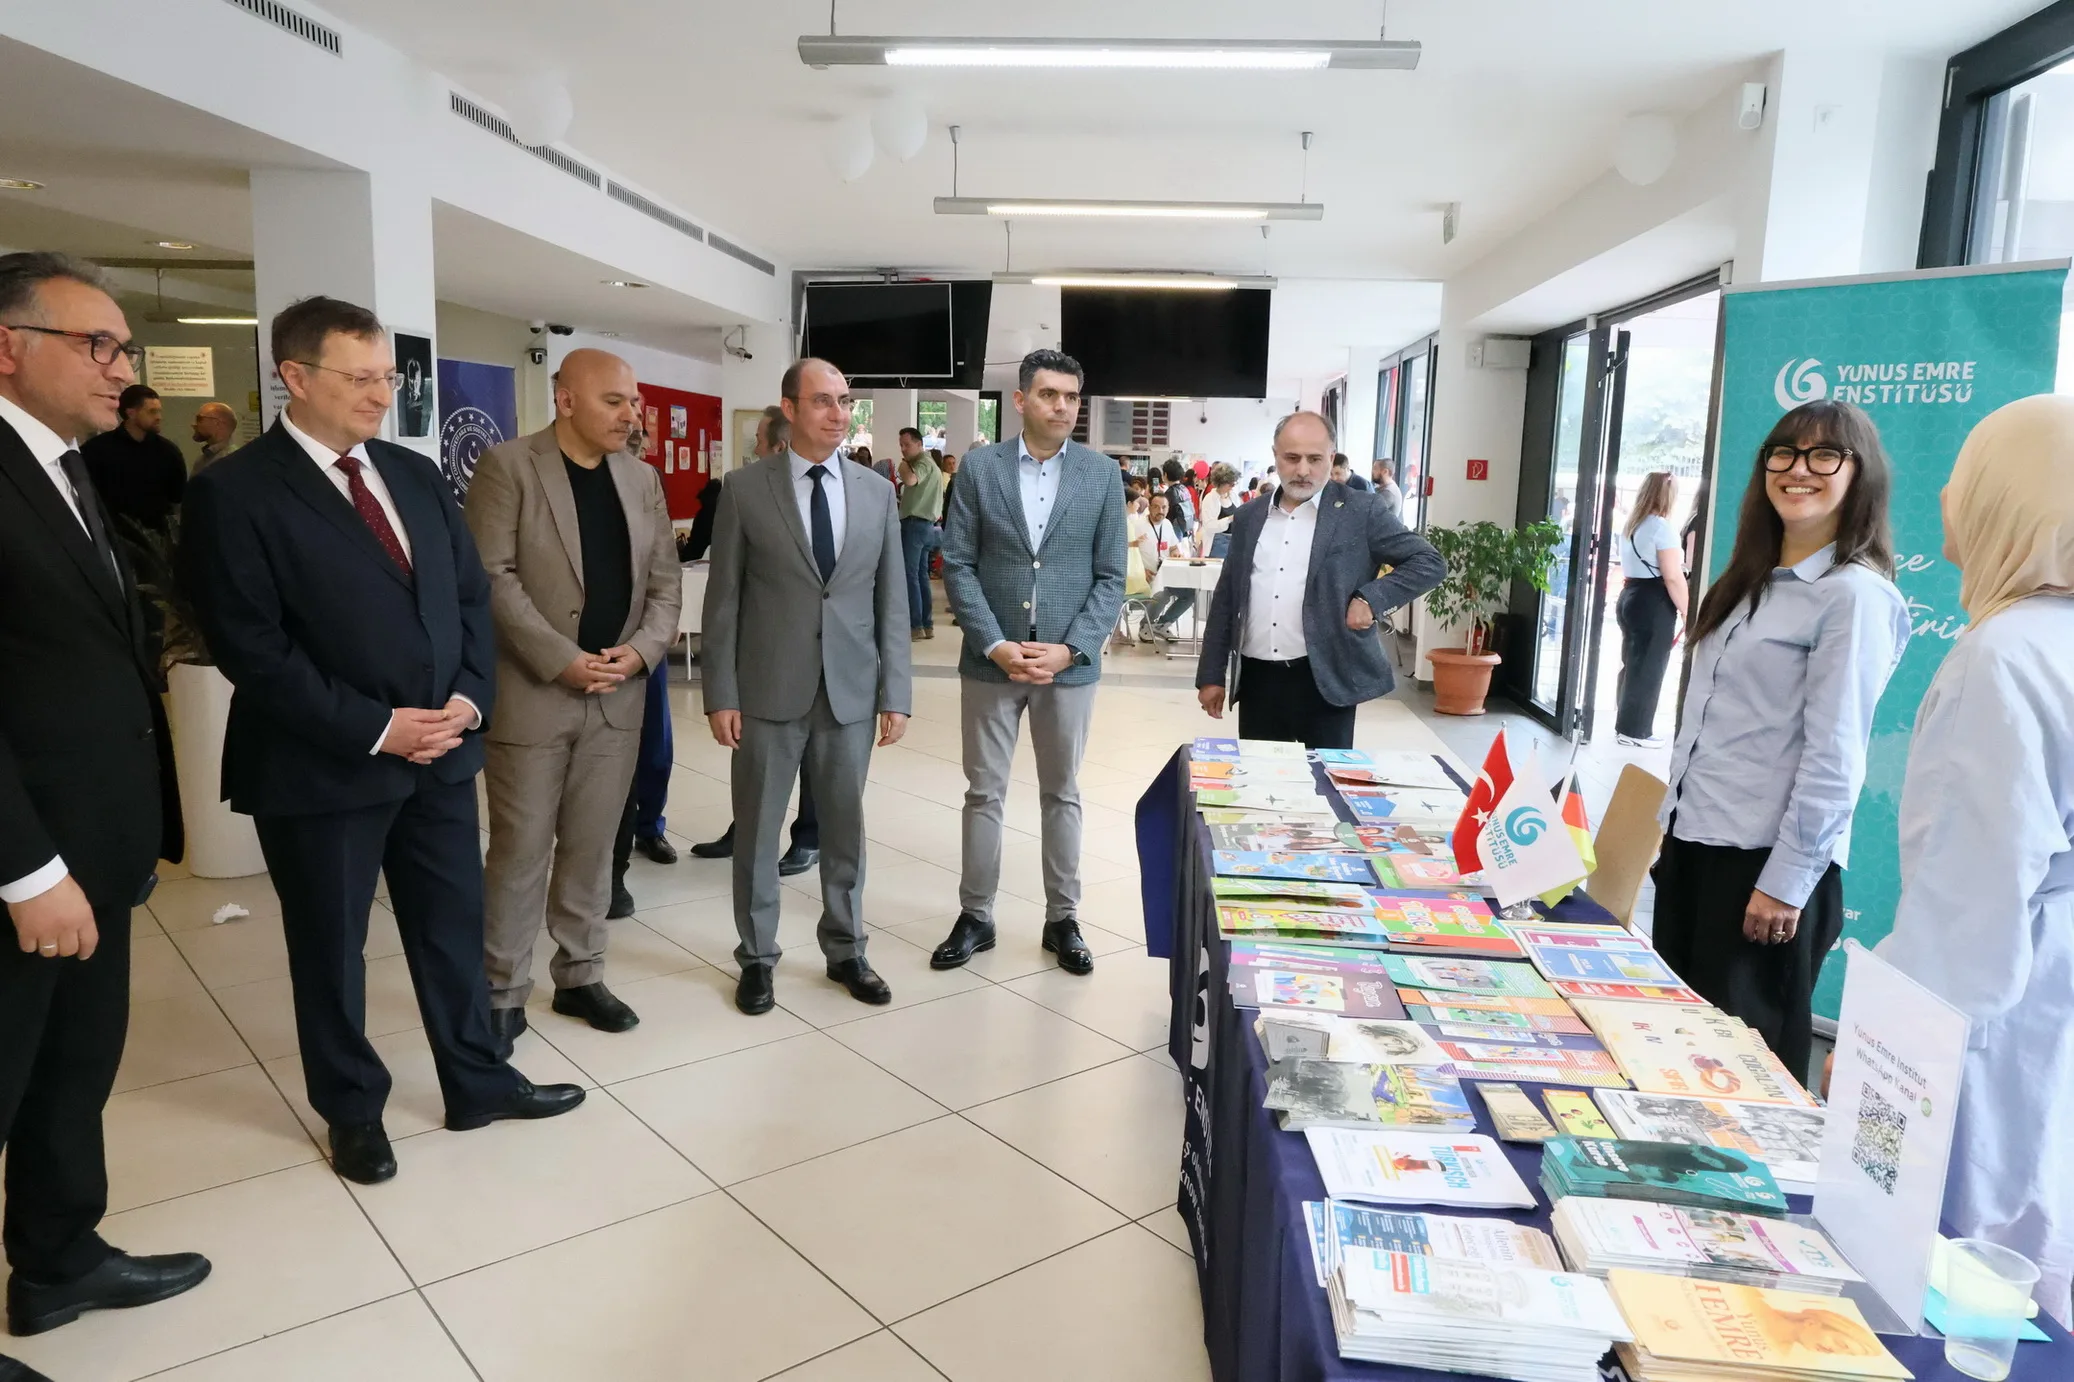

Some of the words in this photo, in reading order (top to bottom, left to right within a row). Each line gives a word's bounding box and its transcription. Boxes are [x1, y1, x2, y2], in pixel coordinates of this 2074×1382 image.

[1837, 363, 1907, 382] YUNUS
[1912, 361, 1977, 381] EMRE
[1832, 383, 1974, 404] ENSTİTÜSÜ
[1498, 839, 1518, 866] EMRE
[1853, 1022, 1875, 1048] Yunus
[1876, 1041, 1896, 1065] Emre
[1896, 1057, 1927, 1089] Institut
[1856, 1046, 1893, 1084] WhatsApp
[1582, 1140, 1609, 1166] Kurse
[1735, 1312, 1772, 1351] Yunus
